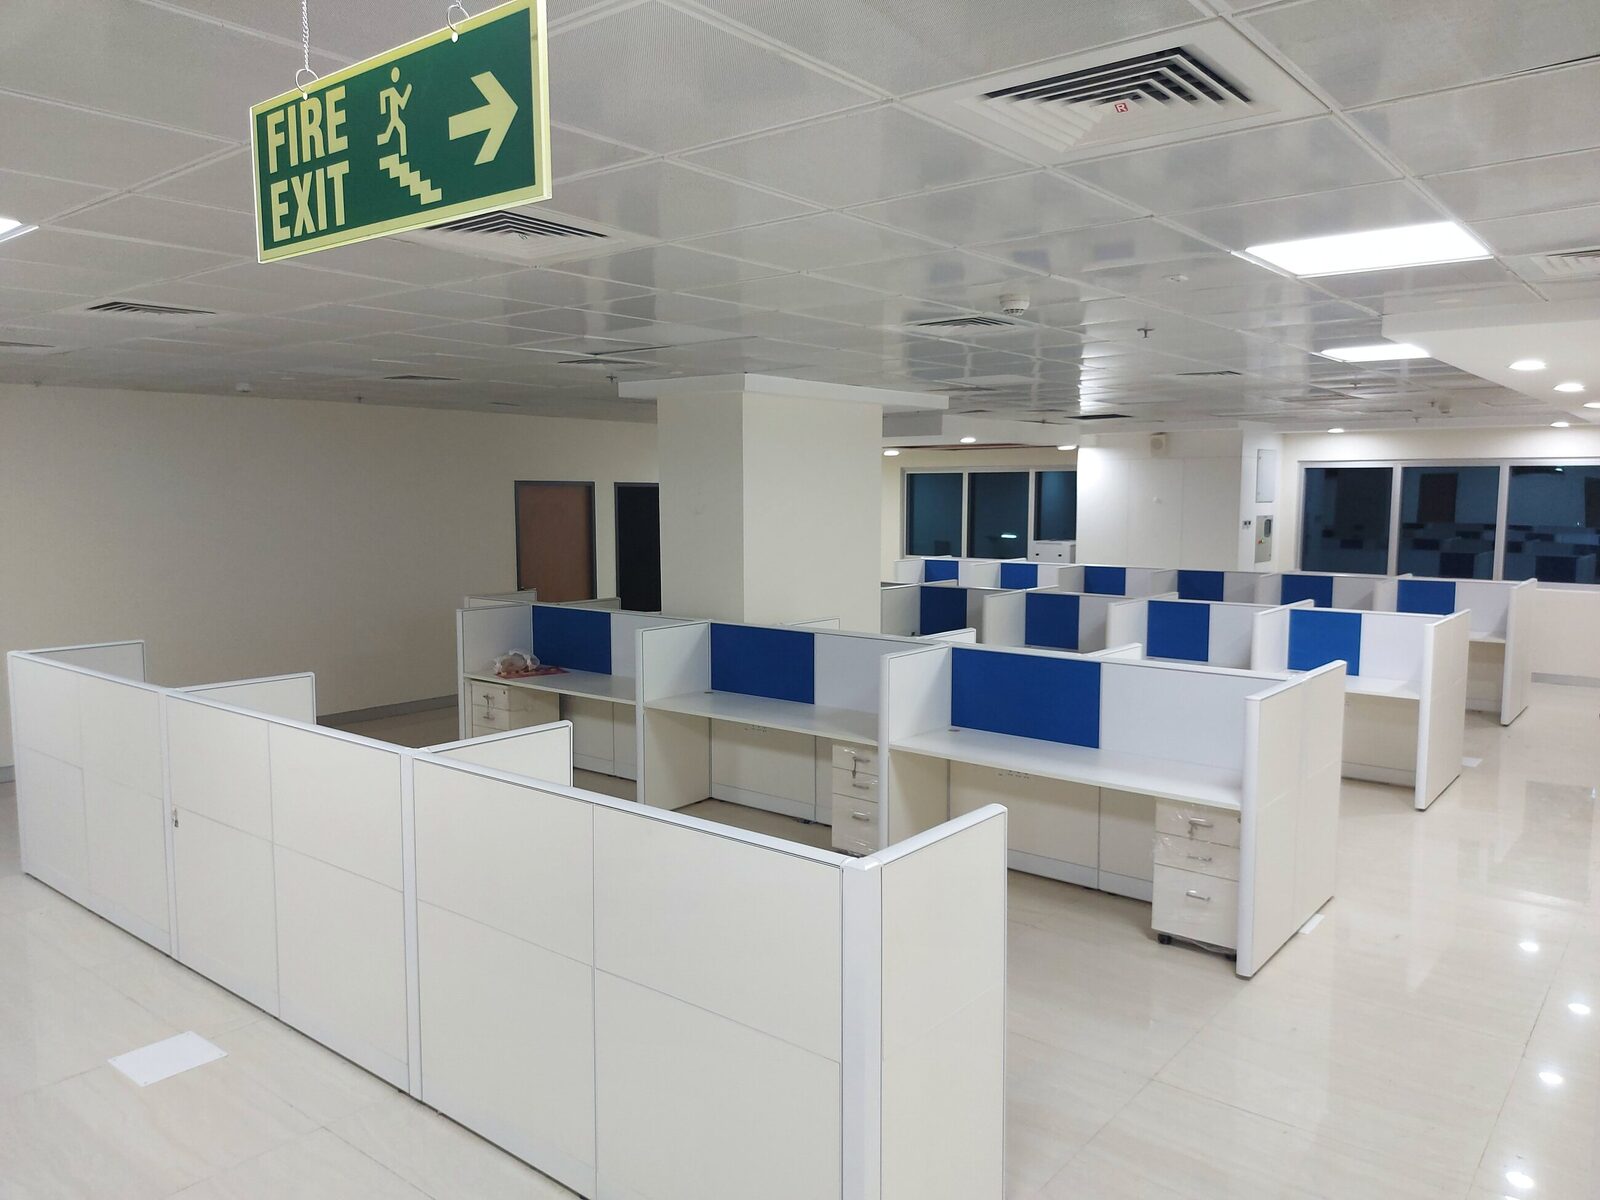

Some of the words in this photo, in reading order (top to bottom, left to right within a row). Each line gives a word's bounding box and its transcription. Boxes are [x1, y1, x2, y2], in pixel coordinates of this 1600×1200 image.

[266, 85, 348, 174] FIRE
[1114, 102, 1129, 113] R
[270, 160, 350, 242] EXIT
